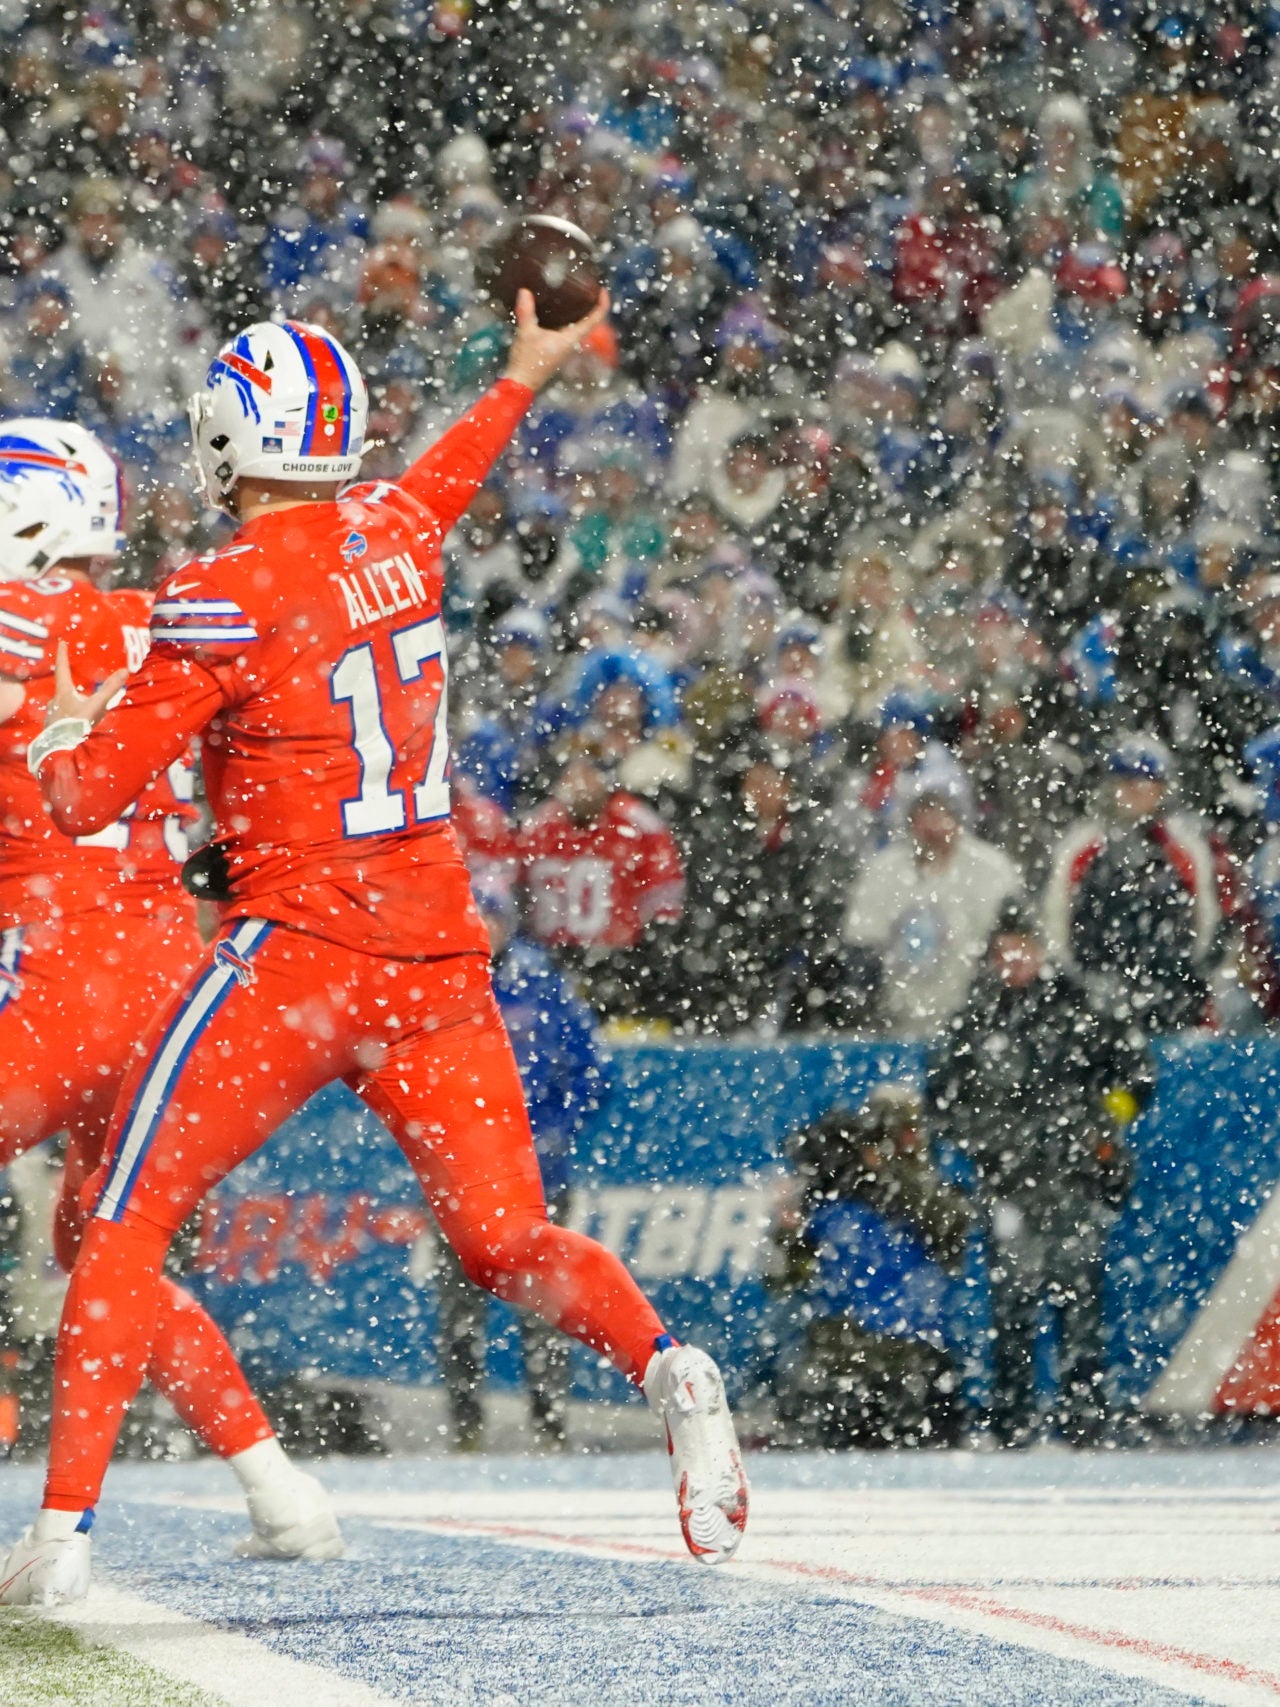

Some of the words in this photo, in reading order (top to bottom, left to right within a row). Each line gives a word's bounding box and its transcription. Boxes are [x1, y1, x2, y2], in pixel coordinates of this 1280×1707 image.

[282, 462, 329, 472] CHOOSE
[332, 463, 352, 472] LOVE
[338, 551, 427, 630] ALLEN
[328, 612, 452, 840] 17
